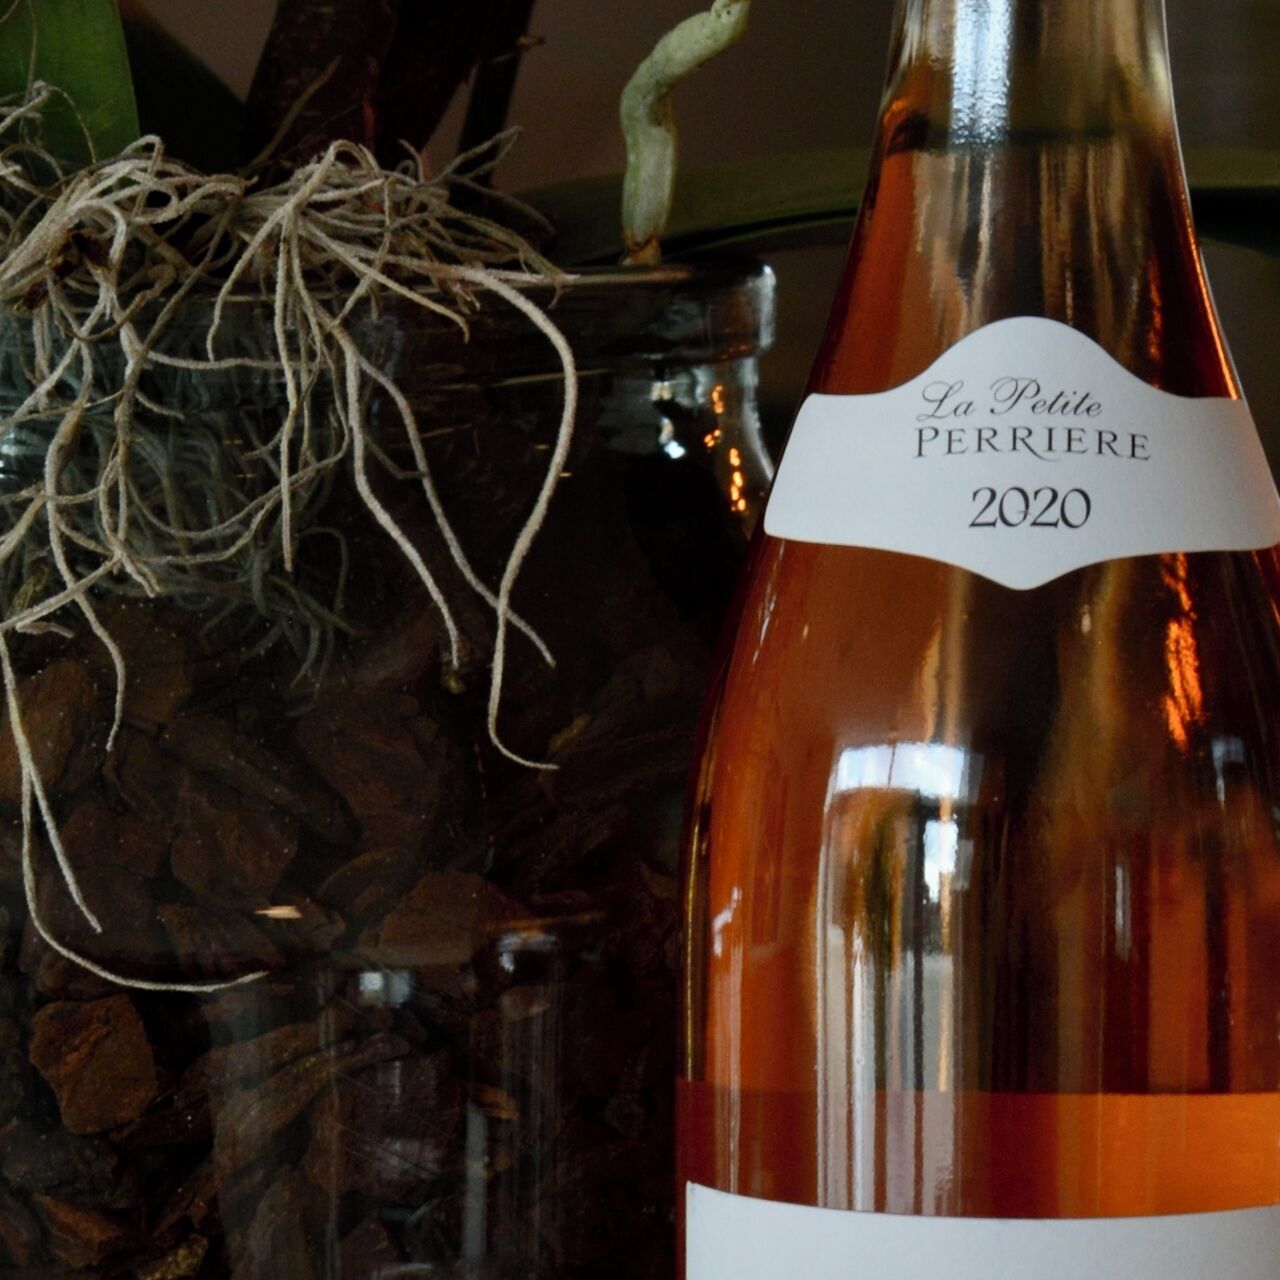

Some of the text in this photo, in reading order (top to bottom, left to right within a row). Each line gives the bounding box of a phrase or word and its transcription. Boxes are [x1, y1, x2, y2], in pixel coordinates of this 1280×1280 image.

[916, 375, 1103, 422] La Petite
[914, 426, 1152, 462] PERRIERE
[968, 486, 1092, 530] 2020
